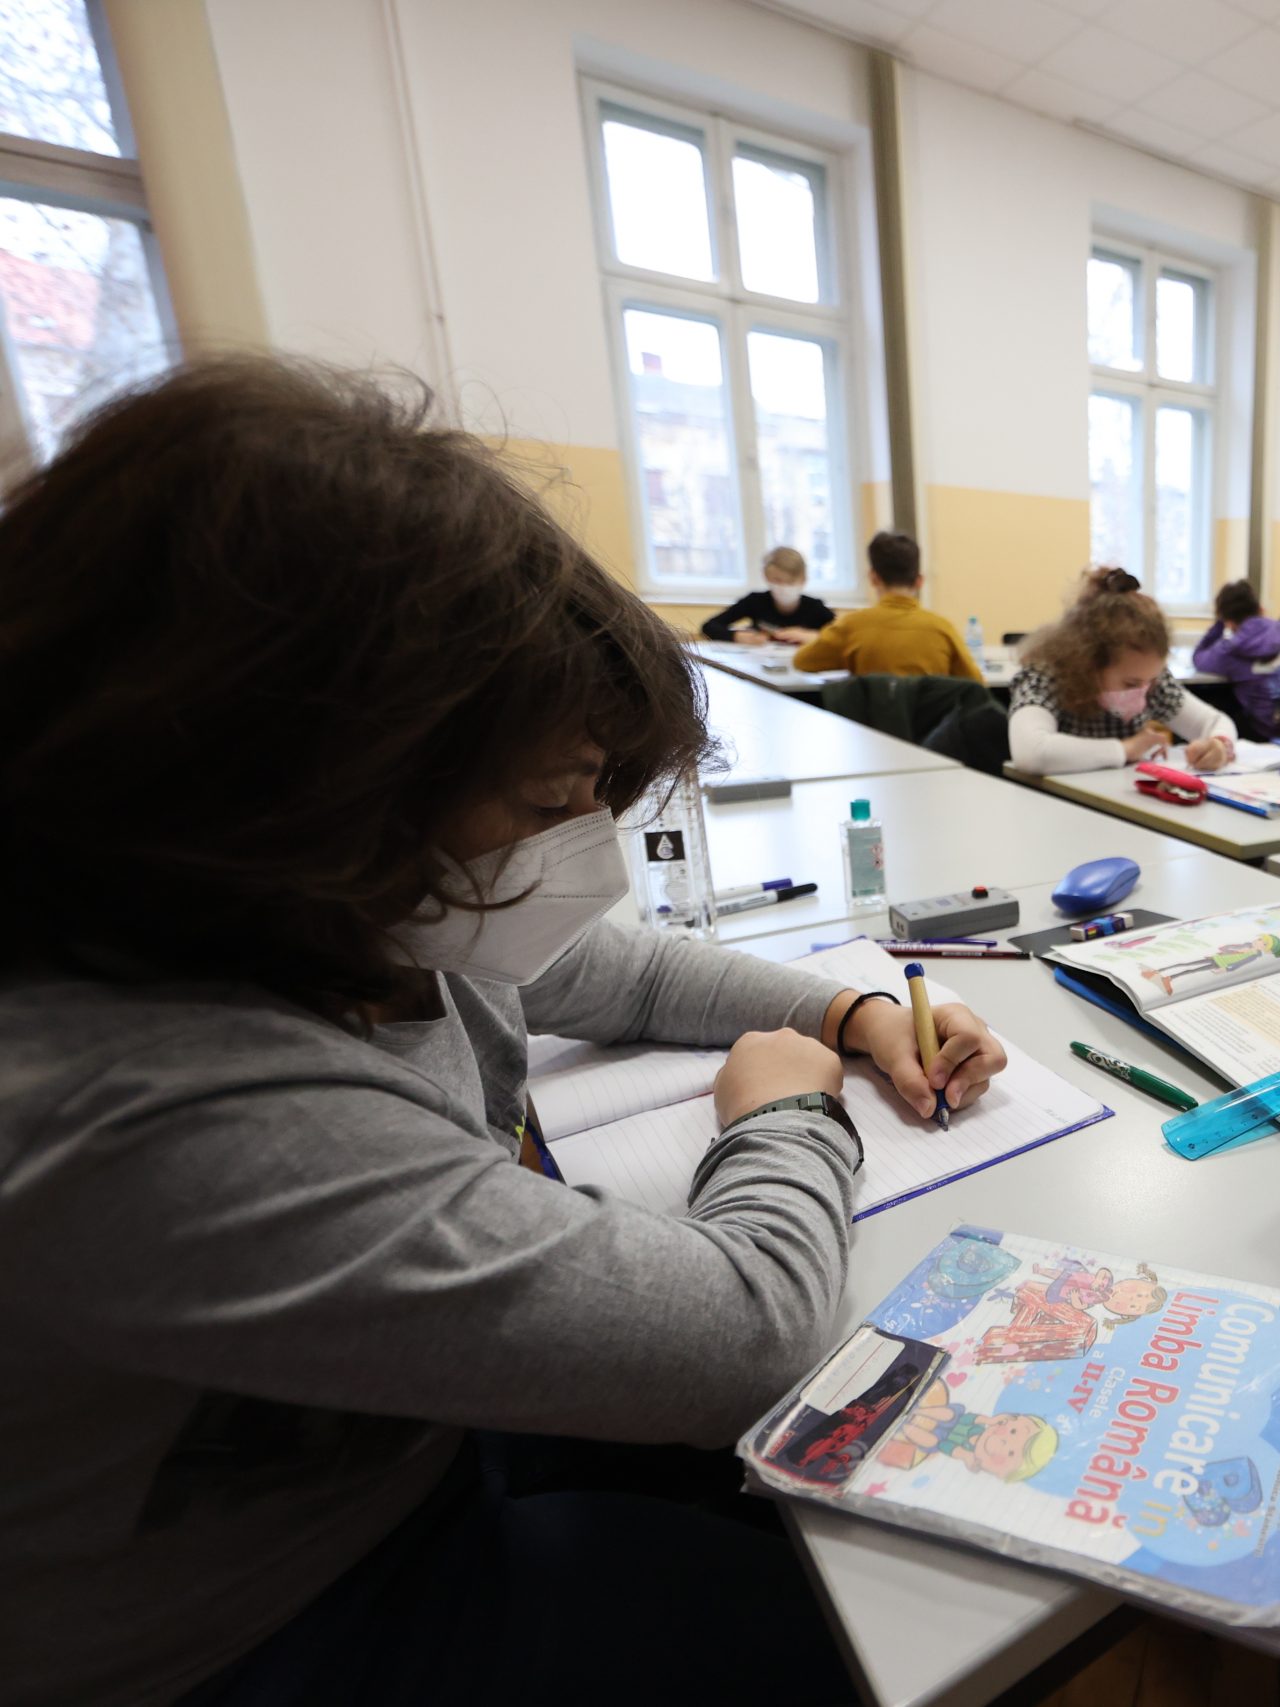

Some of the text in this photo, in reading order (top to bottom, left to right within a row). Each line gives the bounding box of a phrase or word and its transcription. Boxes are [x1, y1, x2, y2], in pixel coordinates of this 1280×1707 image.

[1064, 1290, 1220, 1530] Limba Română
[1067, 1361, 1107, 1415] II-IV
[1089, 1366, 1126, 1419] Clasele
[1133, 1302, 1276, 1538] Comunicare în
